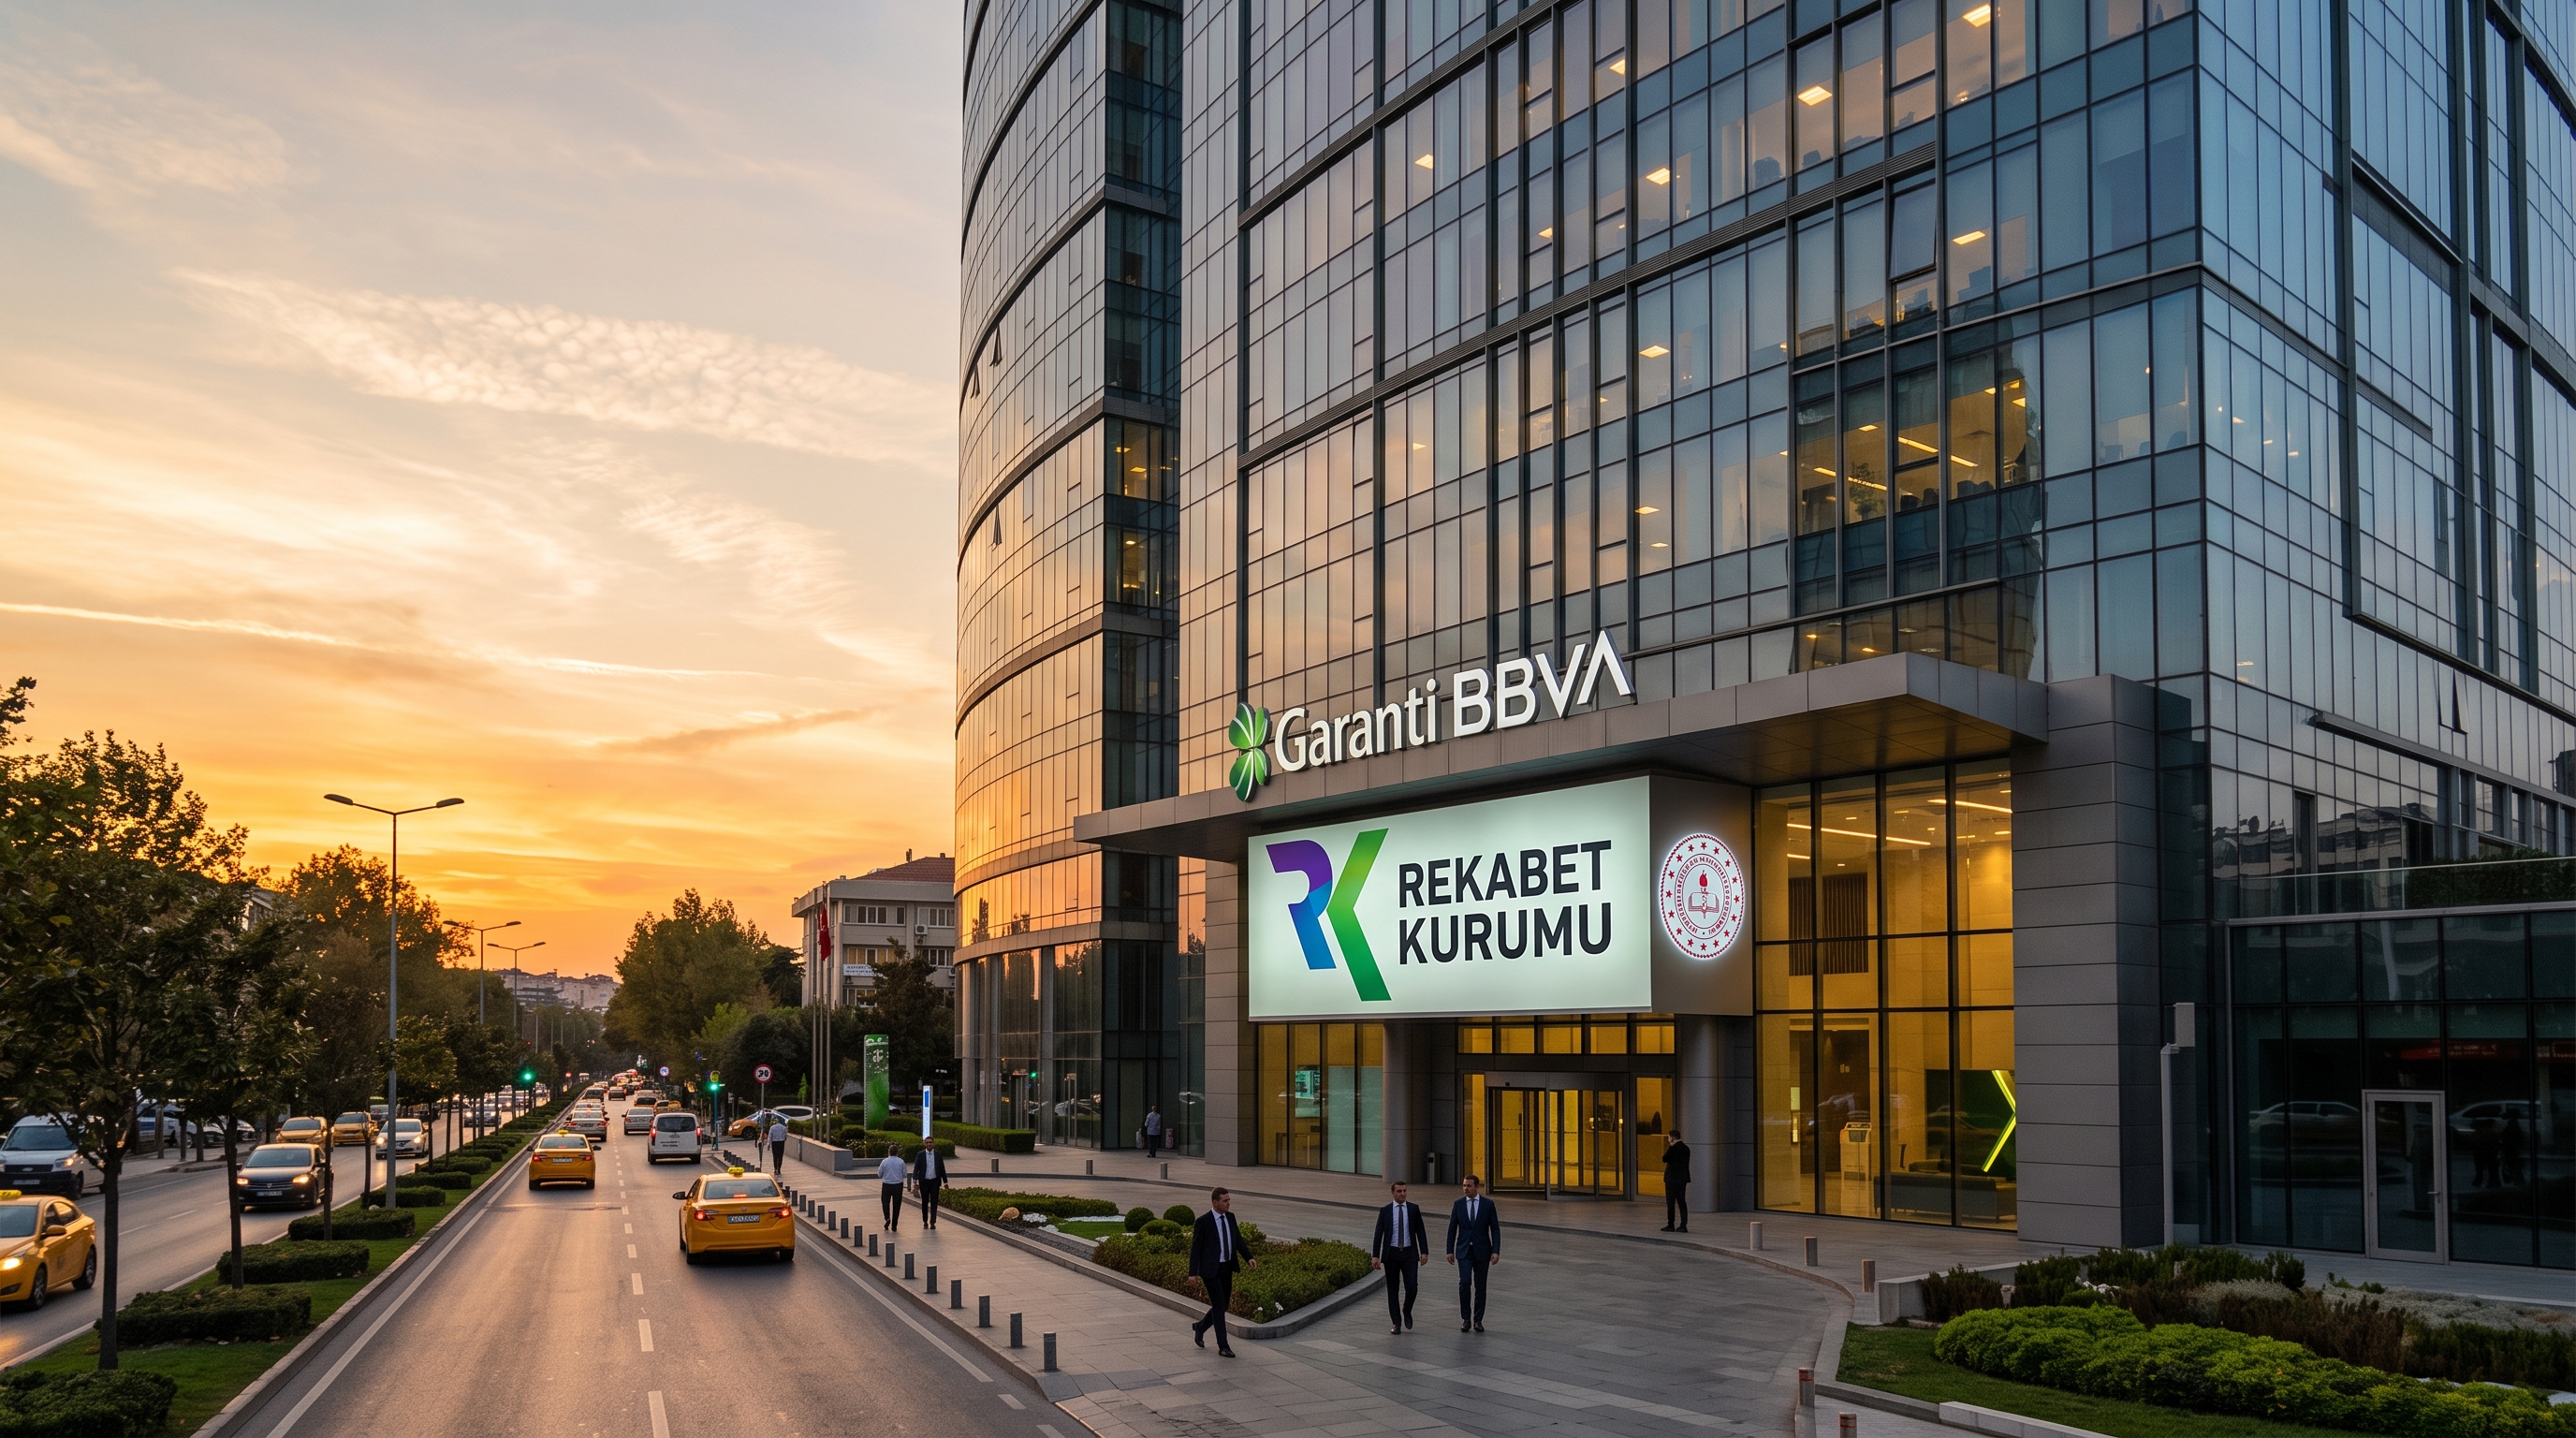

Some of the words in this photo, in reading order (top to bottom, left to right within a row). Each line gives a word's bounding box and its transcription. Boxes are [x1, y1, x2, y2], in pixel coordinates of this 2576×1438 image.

[1274, 678, 1438, 772] Garanti
[1453, 629, 1633, 738] BBVA
[1398, 840, 1612, 908] REKABET
[1398, 902, 1612, 965] KURUMU
